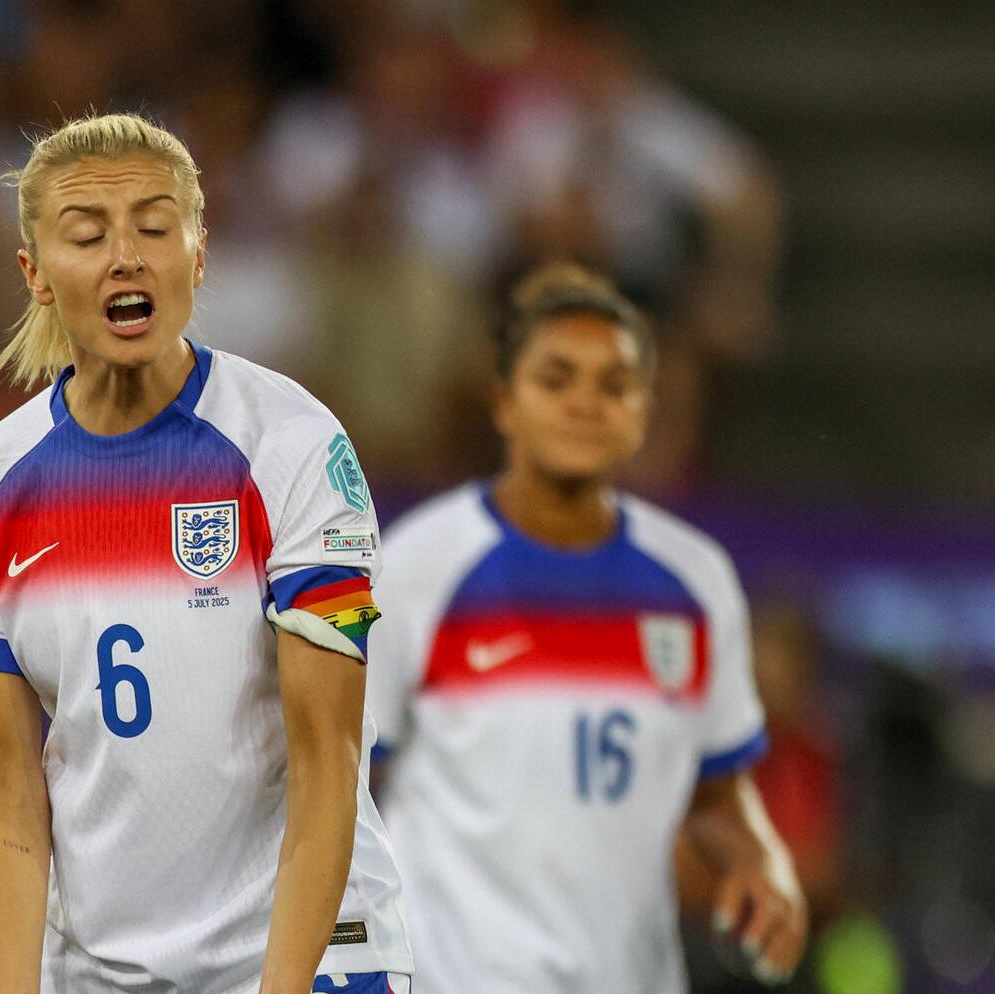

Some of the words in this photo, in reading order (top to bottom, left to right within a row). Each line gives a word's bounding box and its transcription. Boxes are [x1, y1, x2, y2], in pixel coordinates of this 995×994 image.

[194, 586, 220, 597] FRANCE
[187, 599, 193, 609] 5
[194, 598, 210, 609] JULY
[211, 596, 230, 607] 2025
[95, 623, 153, 739] 6
